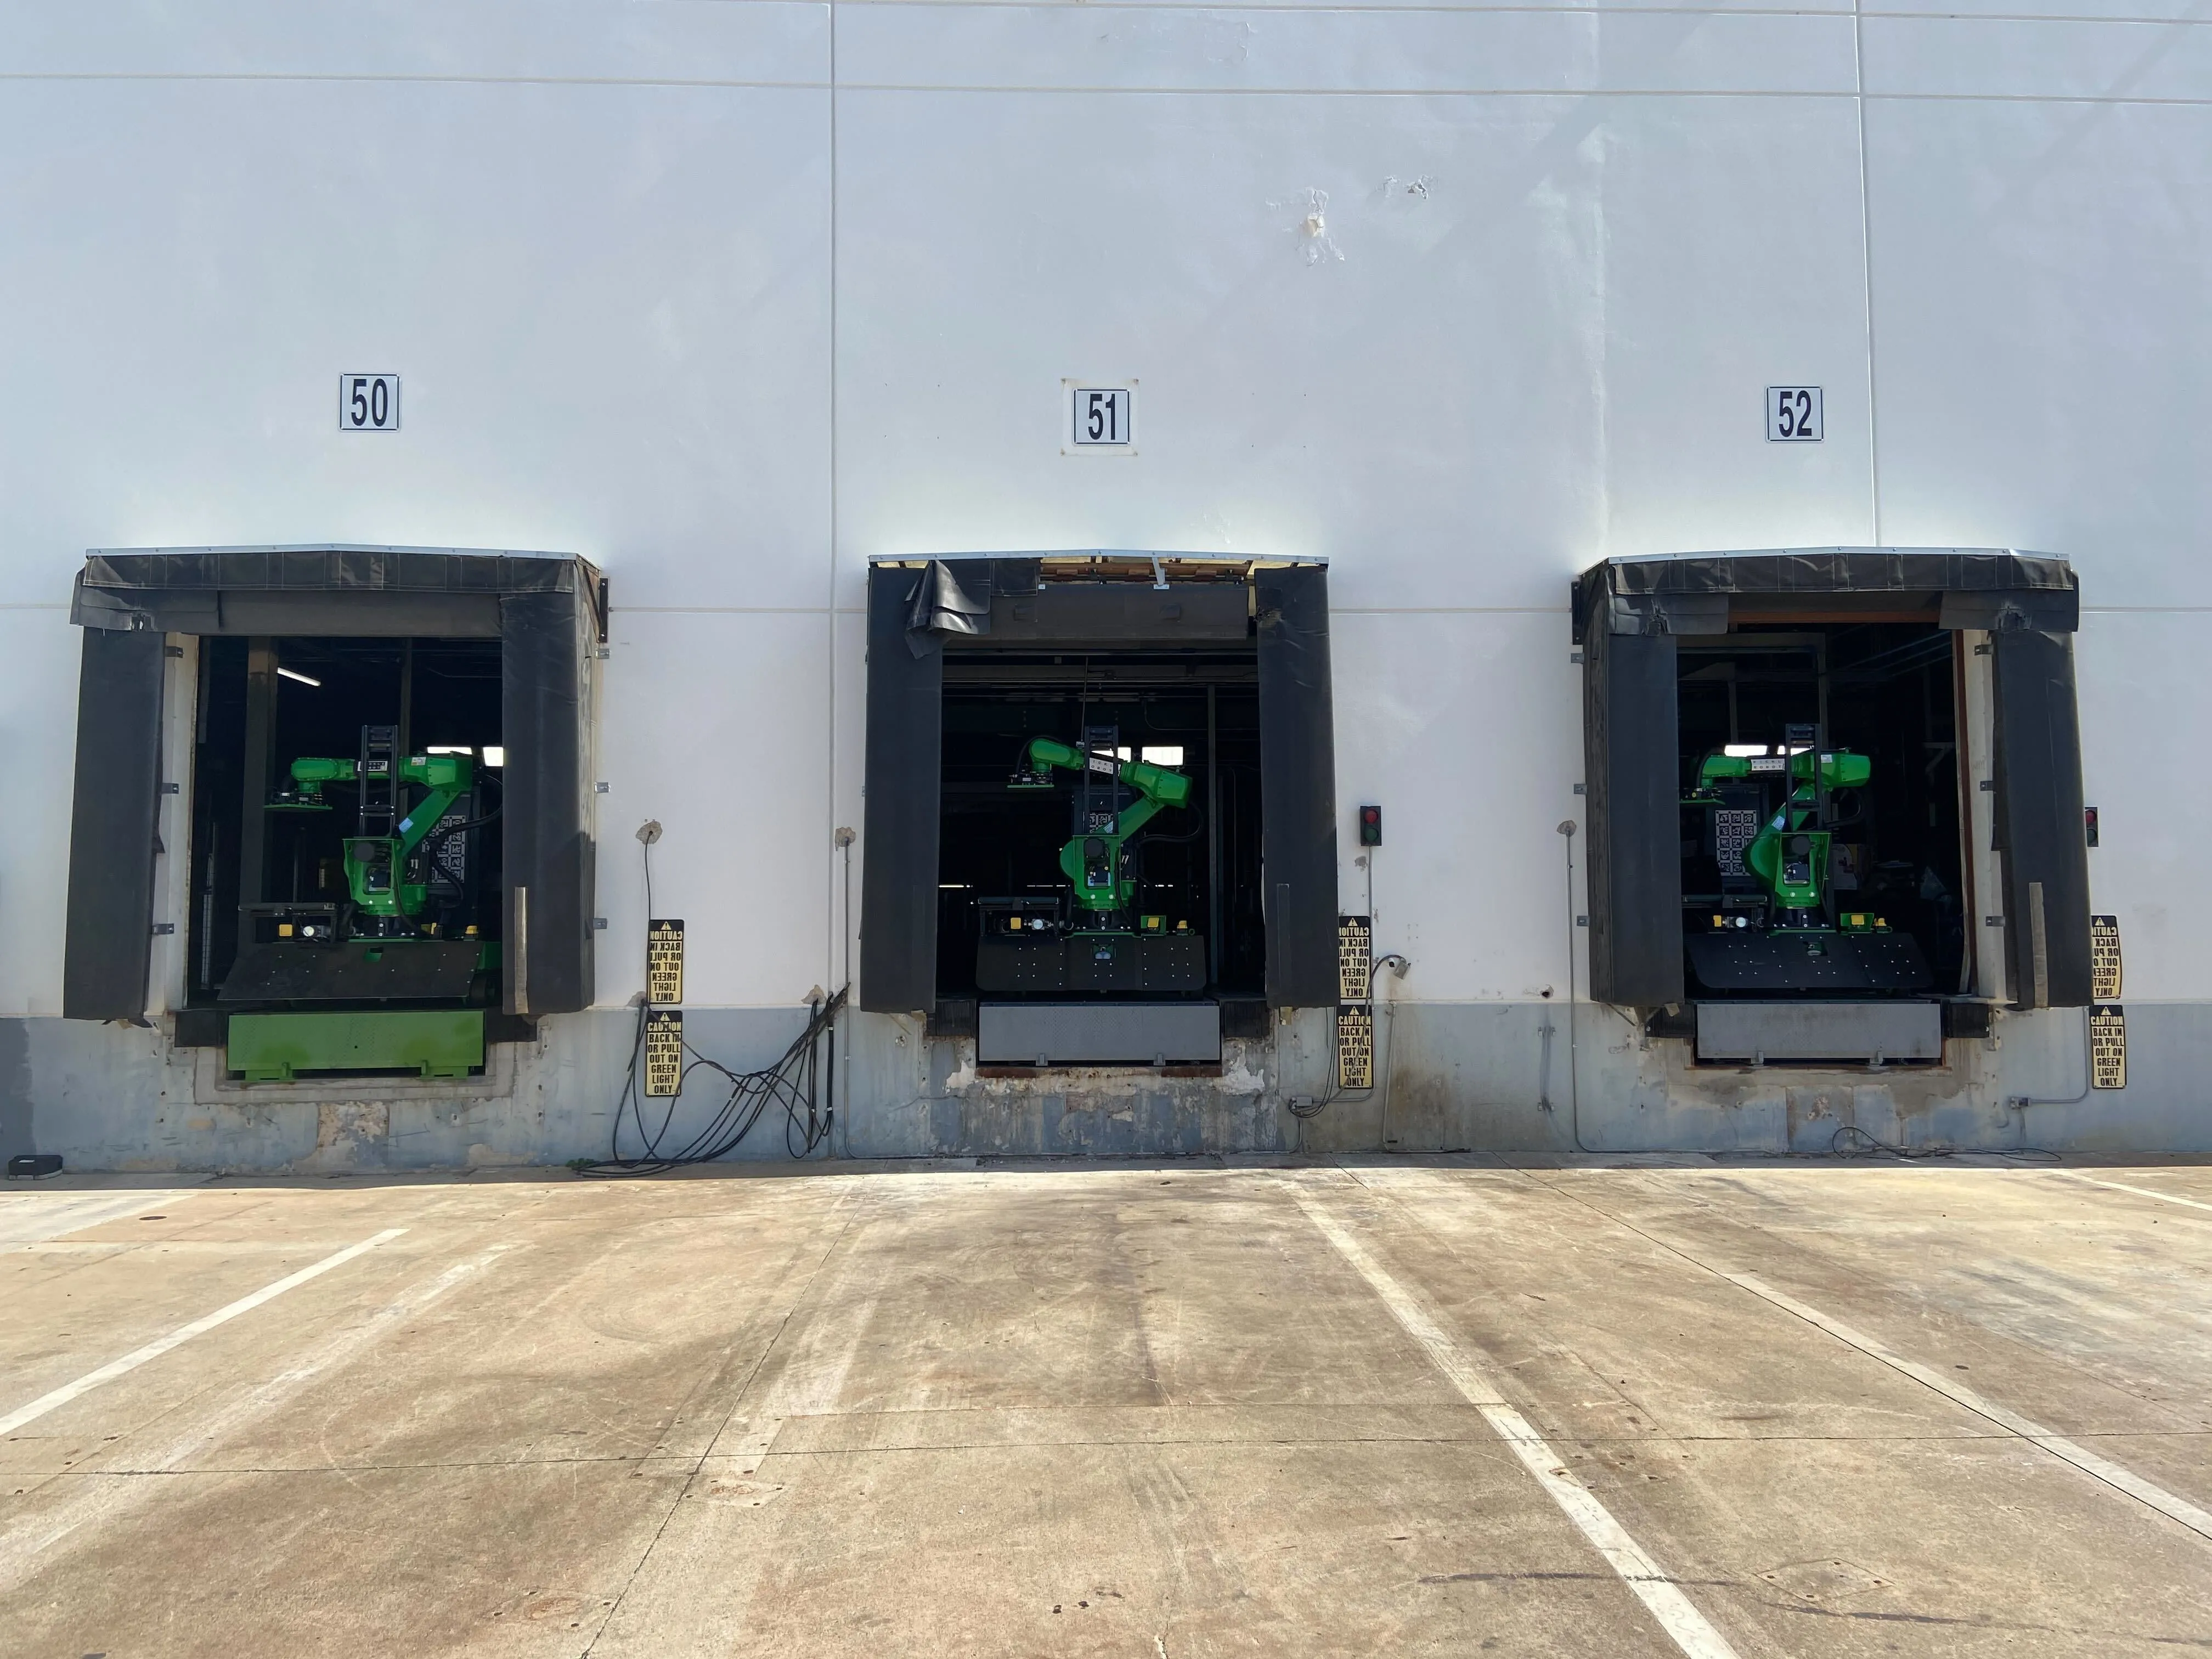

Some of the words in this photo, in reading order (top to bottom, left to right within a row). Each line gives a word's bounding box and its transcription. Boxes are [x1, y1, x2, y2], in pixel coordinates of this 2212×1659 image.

[351, 379, 388, 427] 50
[1088, 393, 1115, 440] 51
[1779, 390, 1812, 437] 52
[2091, 1016, 2123, 1025] CAUTION
[648, 1022, 681, 1031] CAUTION
[1341, 1028, 1360, 1036] BACK
[2094, 1028, 2113, 1036] BACK
[2115, 1028, 2122, 1036] IN
[649, 1034, 670, 1042] BACK
[673, 1034, 680, 1042] IN
[1340, 1037, 1349, 1046] OR
[1352, 1037, 1370, 1046] PULL
[2094, 1038, 2103, 1046] OR
[2106, 1038, 2124, 1046] PULL
[648, 1044, 658, 1053] OR
[662, 1044, 680, 1053] PULL
[1342, 1048, 1356, 1056] OUT
[2096, 1048, 2111, 1056] OUT
[2113, 1048, 2122, 1056] ON
[650, 1054, 665, 1063] OUT
[668, 1054, 678, 1063] ON
[2097, 1058, 2120, 1066] GREEN
[652, 1065, 676, 1073] GREEN
[2098, 1068, 2119, 1076] LIGHT
[652, 1075, 674, 1084] LIGHT
[1347, 1078, 1364, 1086] ONLY
[2101, 1078, 2118, 1086] ONLY
[654, 1085, 673, 1093] ONLY
